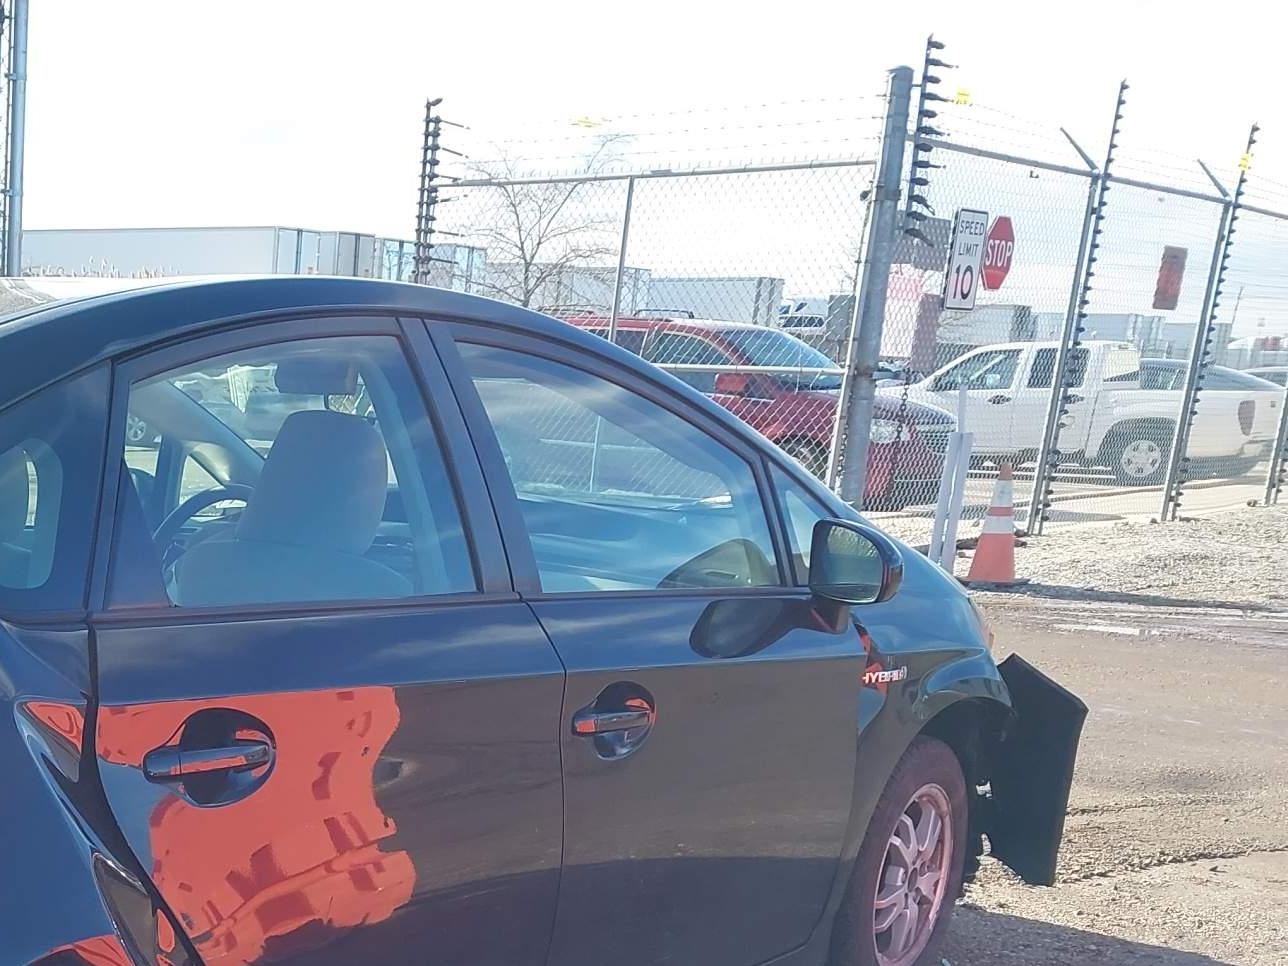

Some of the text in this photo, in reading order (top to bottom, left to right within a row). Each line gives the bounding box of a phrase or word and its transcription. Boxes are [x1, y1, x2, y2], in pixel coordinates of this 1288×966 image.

[959, 220, 985, 236] SPEED
[958, 243, 979, 257] LIMIT
[986, 239, 1013, 267] STOP
[952, 263, 974, 300] 10
